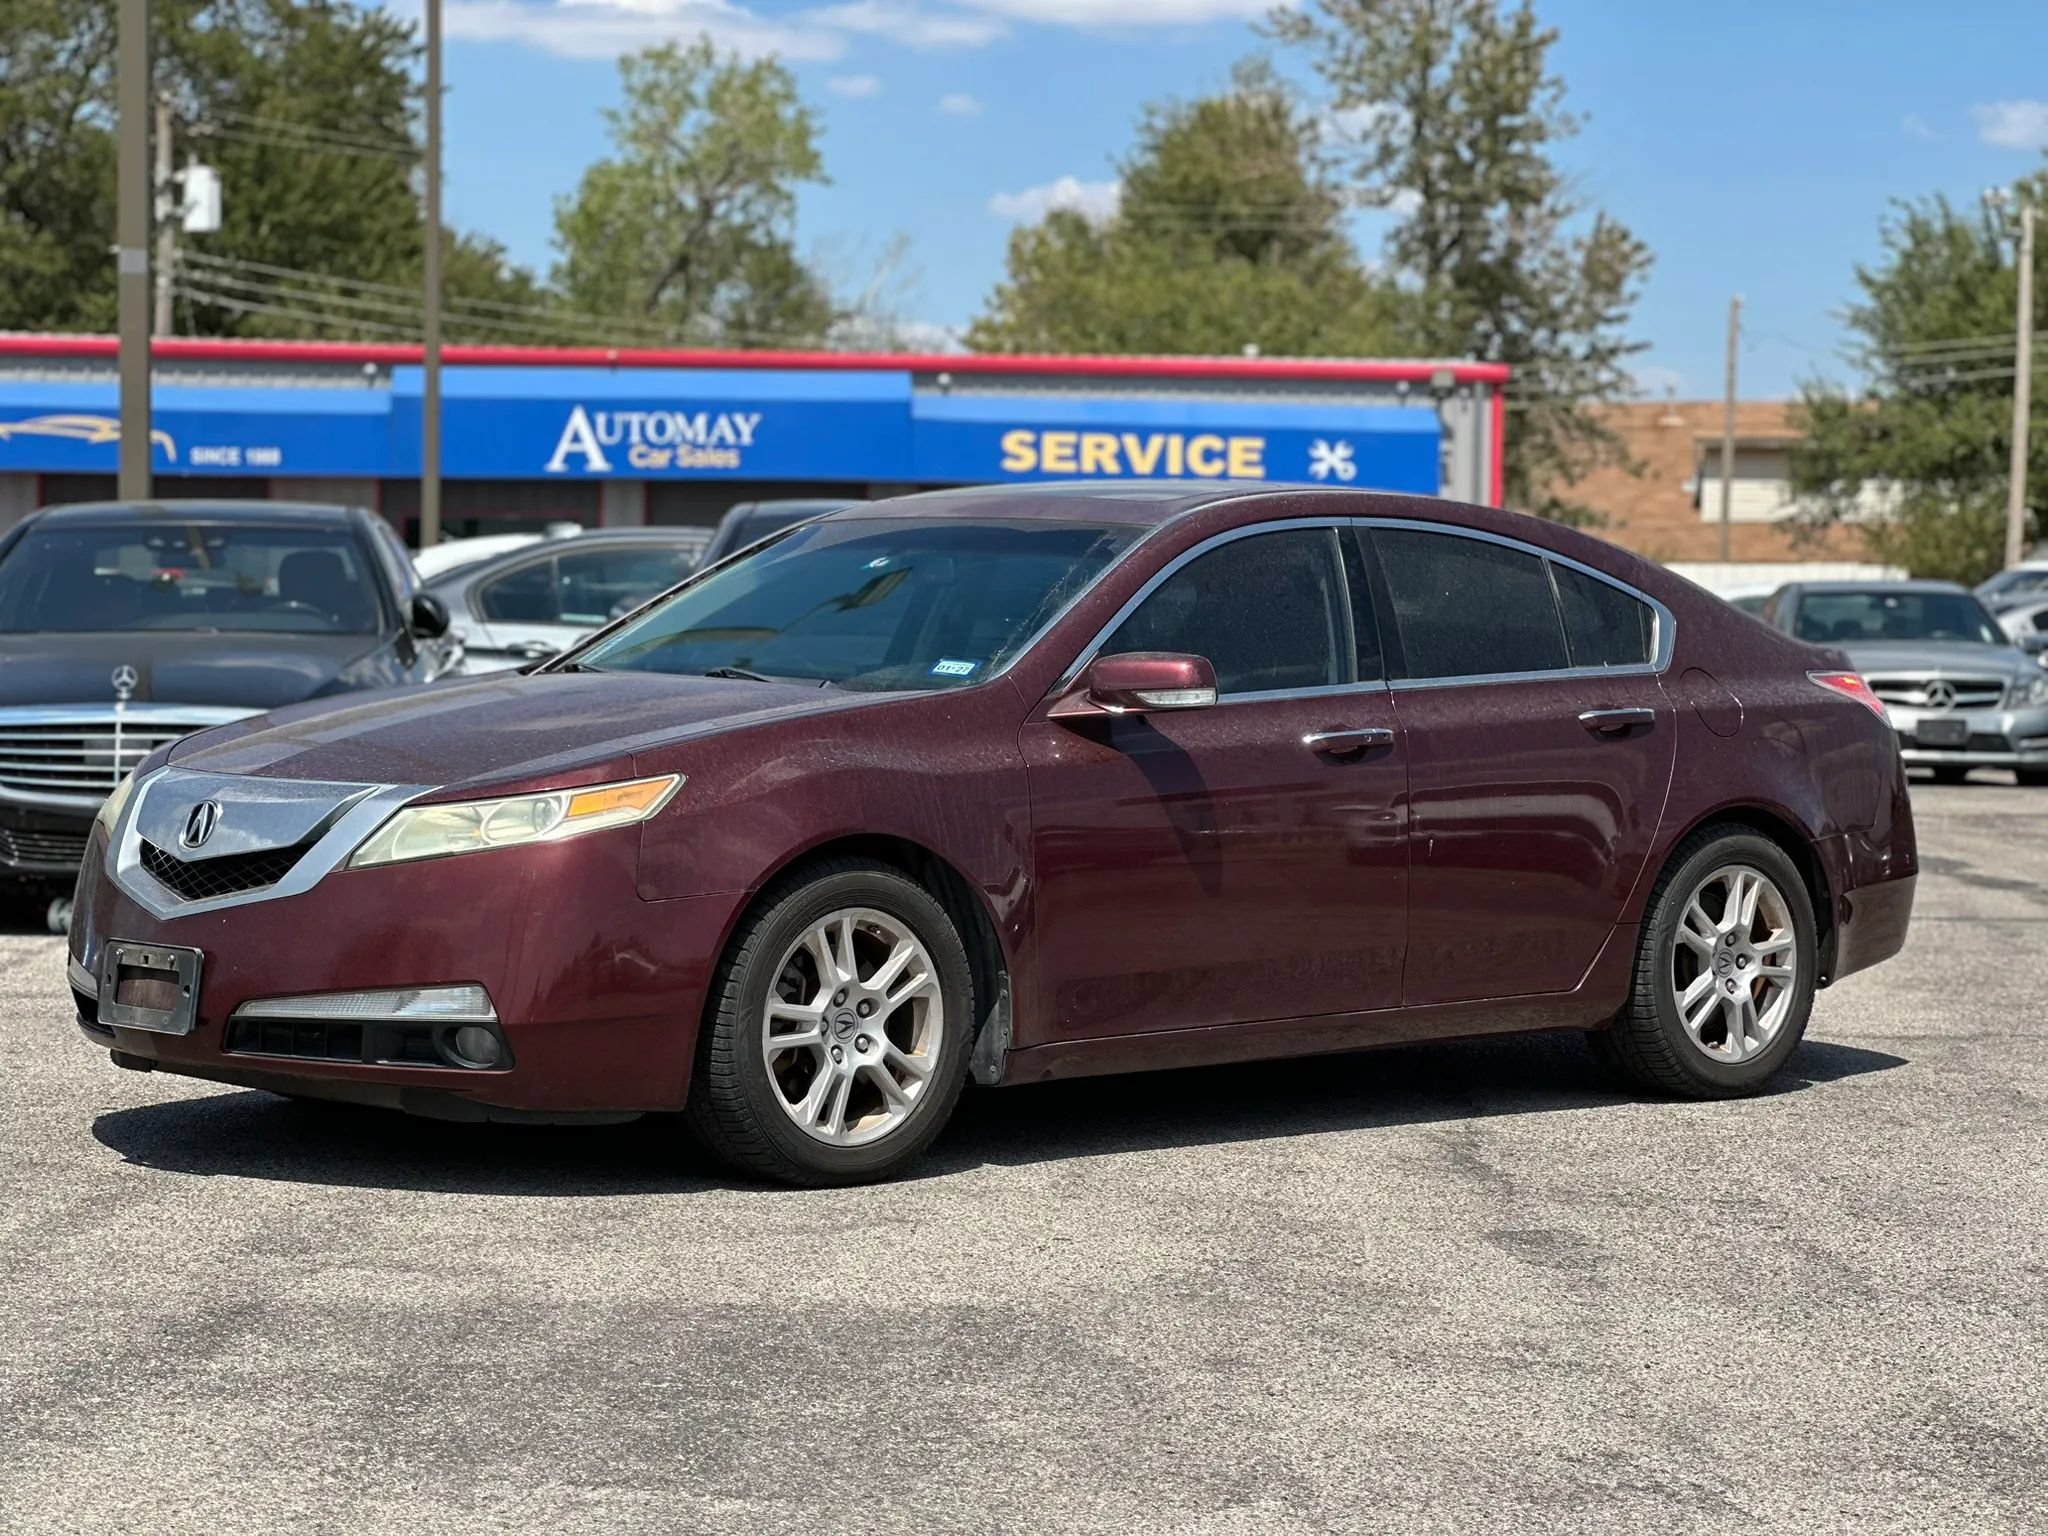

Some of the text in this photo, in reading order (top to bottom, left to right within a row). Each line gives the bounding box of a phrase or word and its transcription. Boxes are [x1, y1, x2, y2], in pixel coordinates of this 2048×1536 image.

[189, 446, 241, 466] SINCE
[544, 404, 761, 472] AUTOMAY
[628, 443, 740, 469] Car Sales
[1001, 429, 1266, 478] SERVICE
